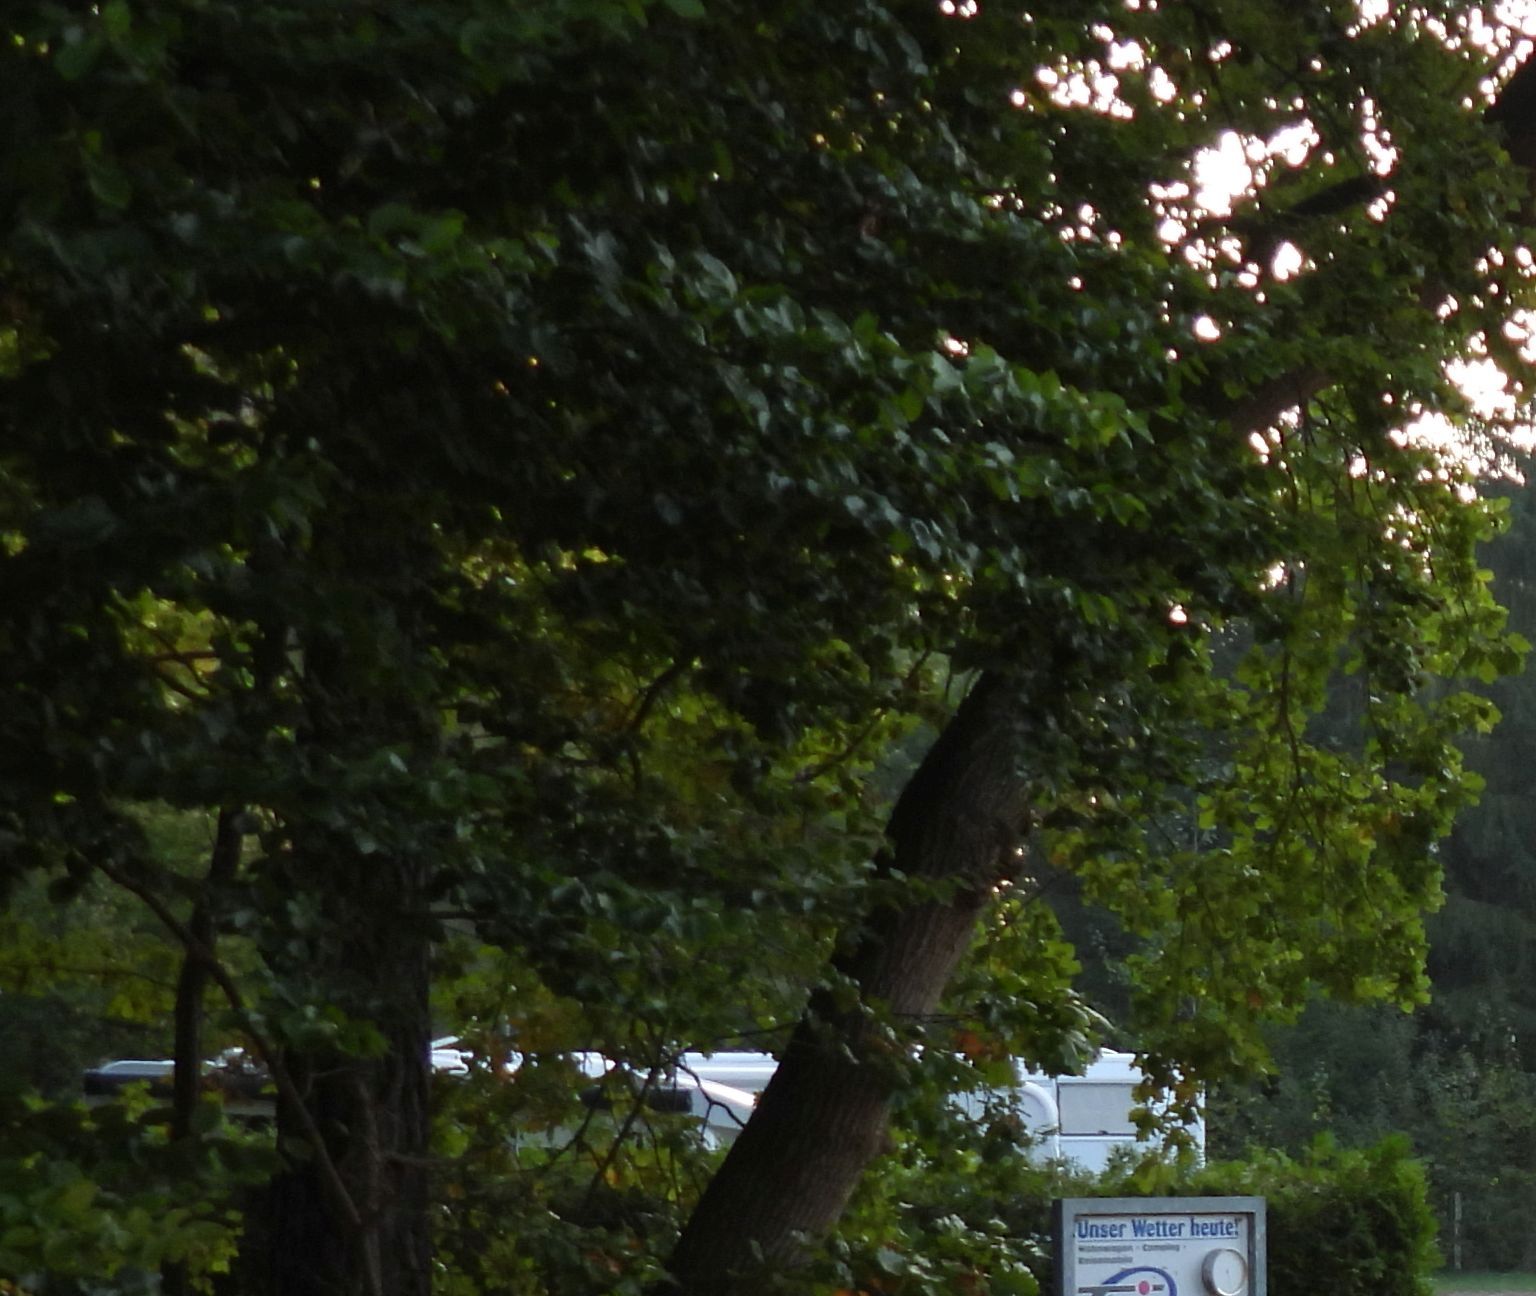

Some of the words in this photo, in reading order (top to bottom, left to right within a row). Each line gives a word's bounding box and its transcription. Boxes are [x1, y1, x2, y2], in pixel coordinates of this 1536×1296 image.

[1077, 1220, 1127, 1239] Unser
[1131, 1218, 1186, 1238] Wetter
[1190, 1216, 1240, 1237] heute!
